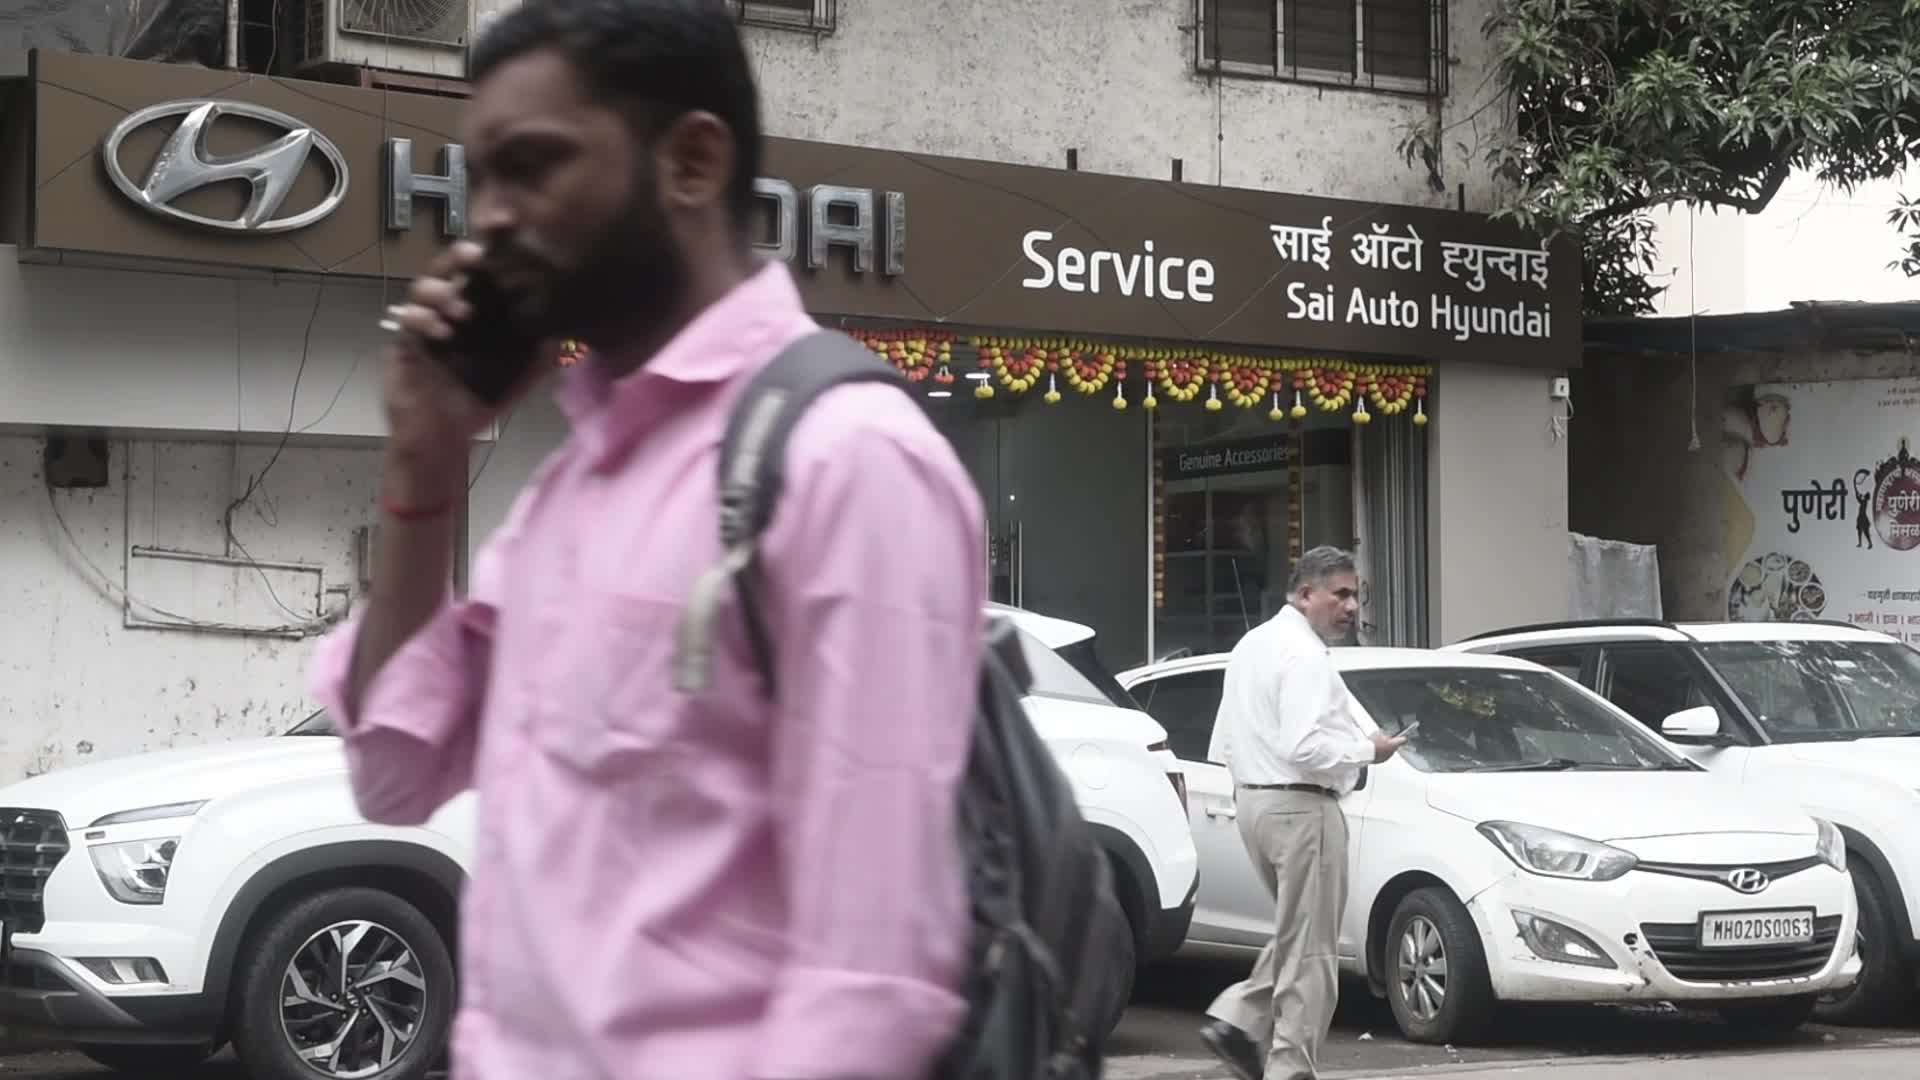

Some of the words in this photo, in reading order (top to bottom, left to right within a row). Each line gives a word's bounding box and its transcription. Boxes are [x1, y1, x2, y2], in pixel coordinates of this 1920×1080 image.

[387, 137, 905, 276] HDAI
[1022, 230, 1215, 302] Service
[1269, 215, 1333, 271] साई
[1350, 222, 1424, 273] ऑटो
[1286, 281, 1334, 322] Sai
[1345, 286, 1420, 329] Auto
[1431, 293, 1551, 341] Hyundai
[1179, 450, 1222, 472] Genuine
[1781, 477, 1849, 534] पुणेरी
[1713, 918, 1811, 940] MH02DS0063
